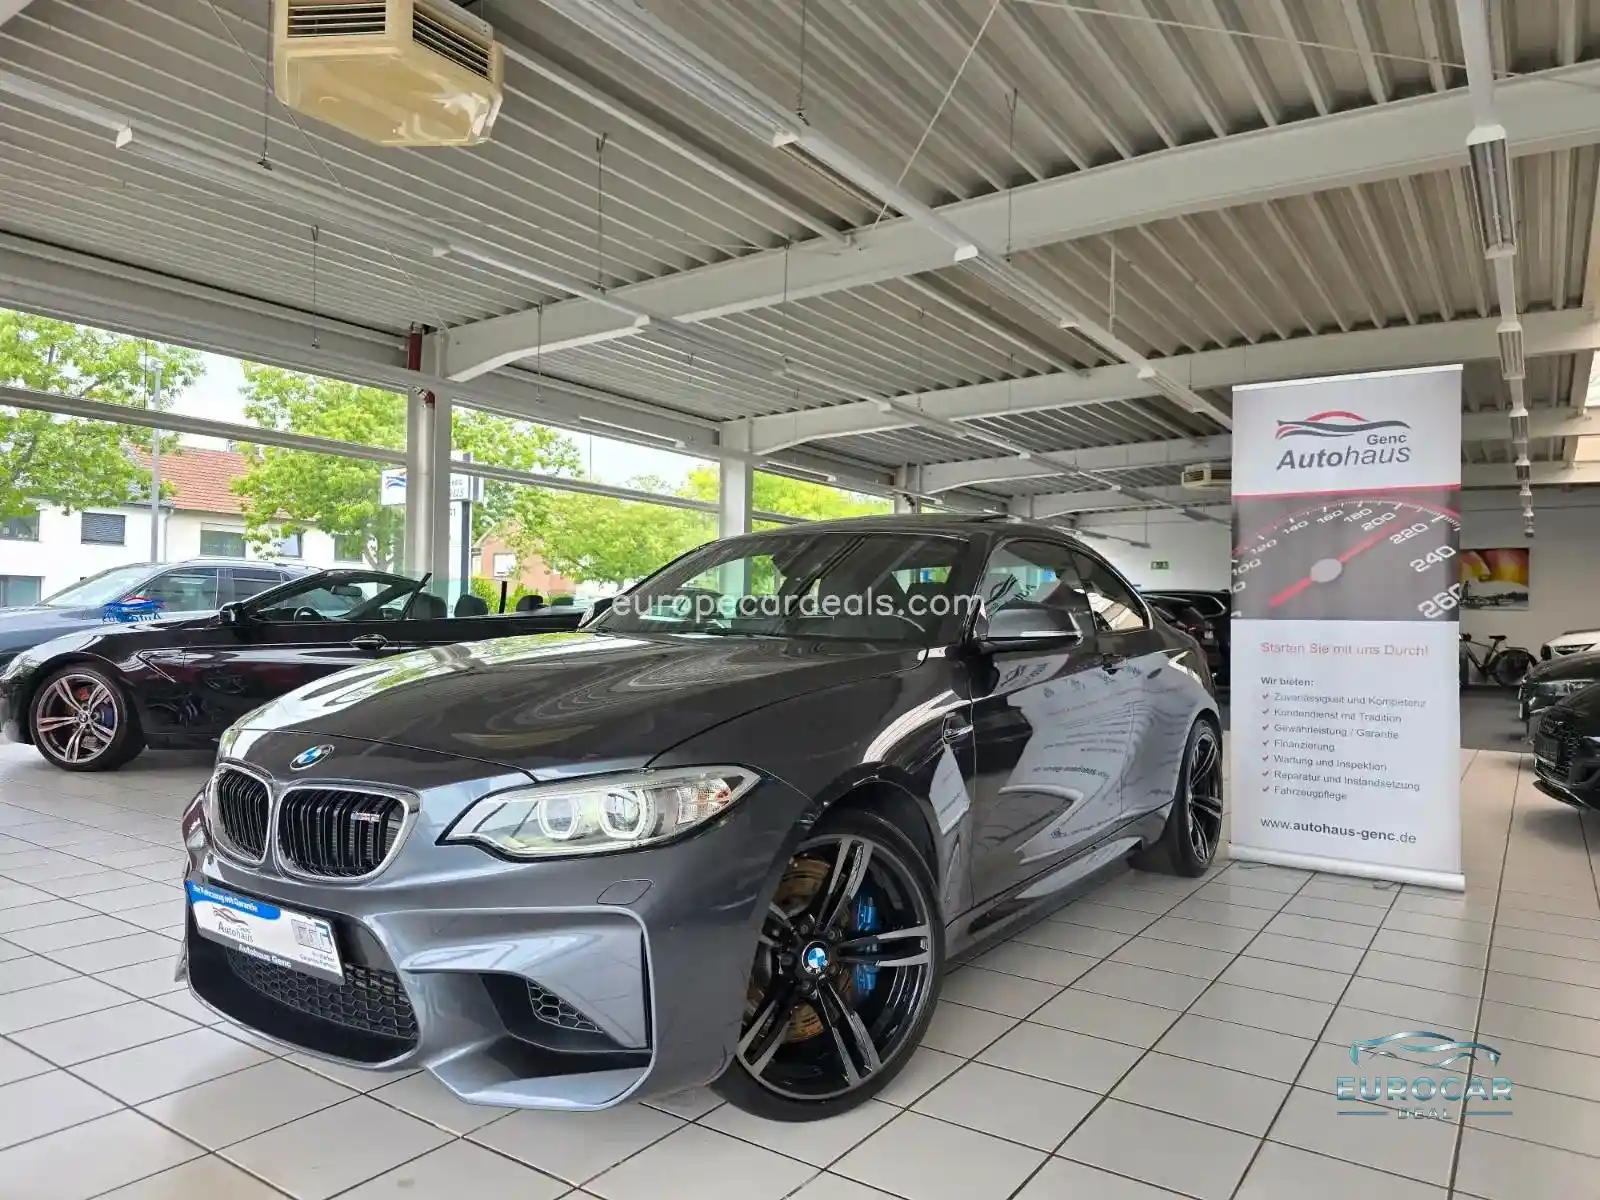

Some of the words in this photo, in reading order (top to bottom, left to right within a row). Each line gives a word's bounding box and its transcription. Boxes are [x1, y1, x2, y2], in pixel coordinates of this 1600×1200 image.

[1367, 432, 1408, 446] Genc
[1276, 445, 1412, 471] Autohaus
[1361, 512, 1396, 531] 200
[1389, 522, 1429, 544] 220
[1409, 545, 1457, 572] 240
[1260, 641, 1305, 655] Starten
[1309, 642, 1330, 655] Sie
[1333, 644, 1353, 656] mit
[1356, 645, 1380, 656] uns
[1384, 644, 1429, 657] Durch!
[1260, 676, 1277, 686] Wir
[1279, 676, 1315, 687] bieten:
[1347, 695, 1366, 705] und
[1340, 711, 1357, 721] mit
[1359, 712, 1402, 723] Tradition
[1356, 728, 1400, 740] Garantie
[1274, 738, 1336, 753] Finanzierung
[1274, 754, 1313, 767] Wartung
[1315, 758, 1334, 768] und
[1336, 759, 1388, 772] Inspektion
[1274, 770, 1321, 782] Reparatur
[1323, 774, 1342, 784] und
[1344, 775, 1421, 792] Instandsetzung
[1274, 785, 1348, 802] Fahrzeugpflege
[1260, 817, 1418, 844] www.autohaus-genc.de
[217, 920, 254, 944] Autohaus
